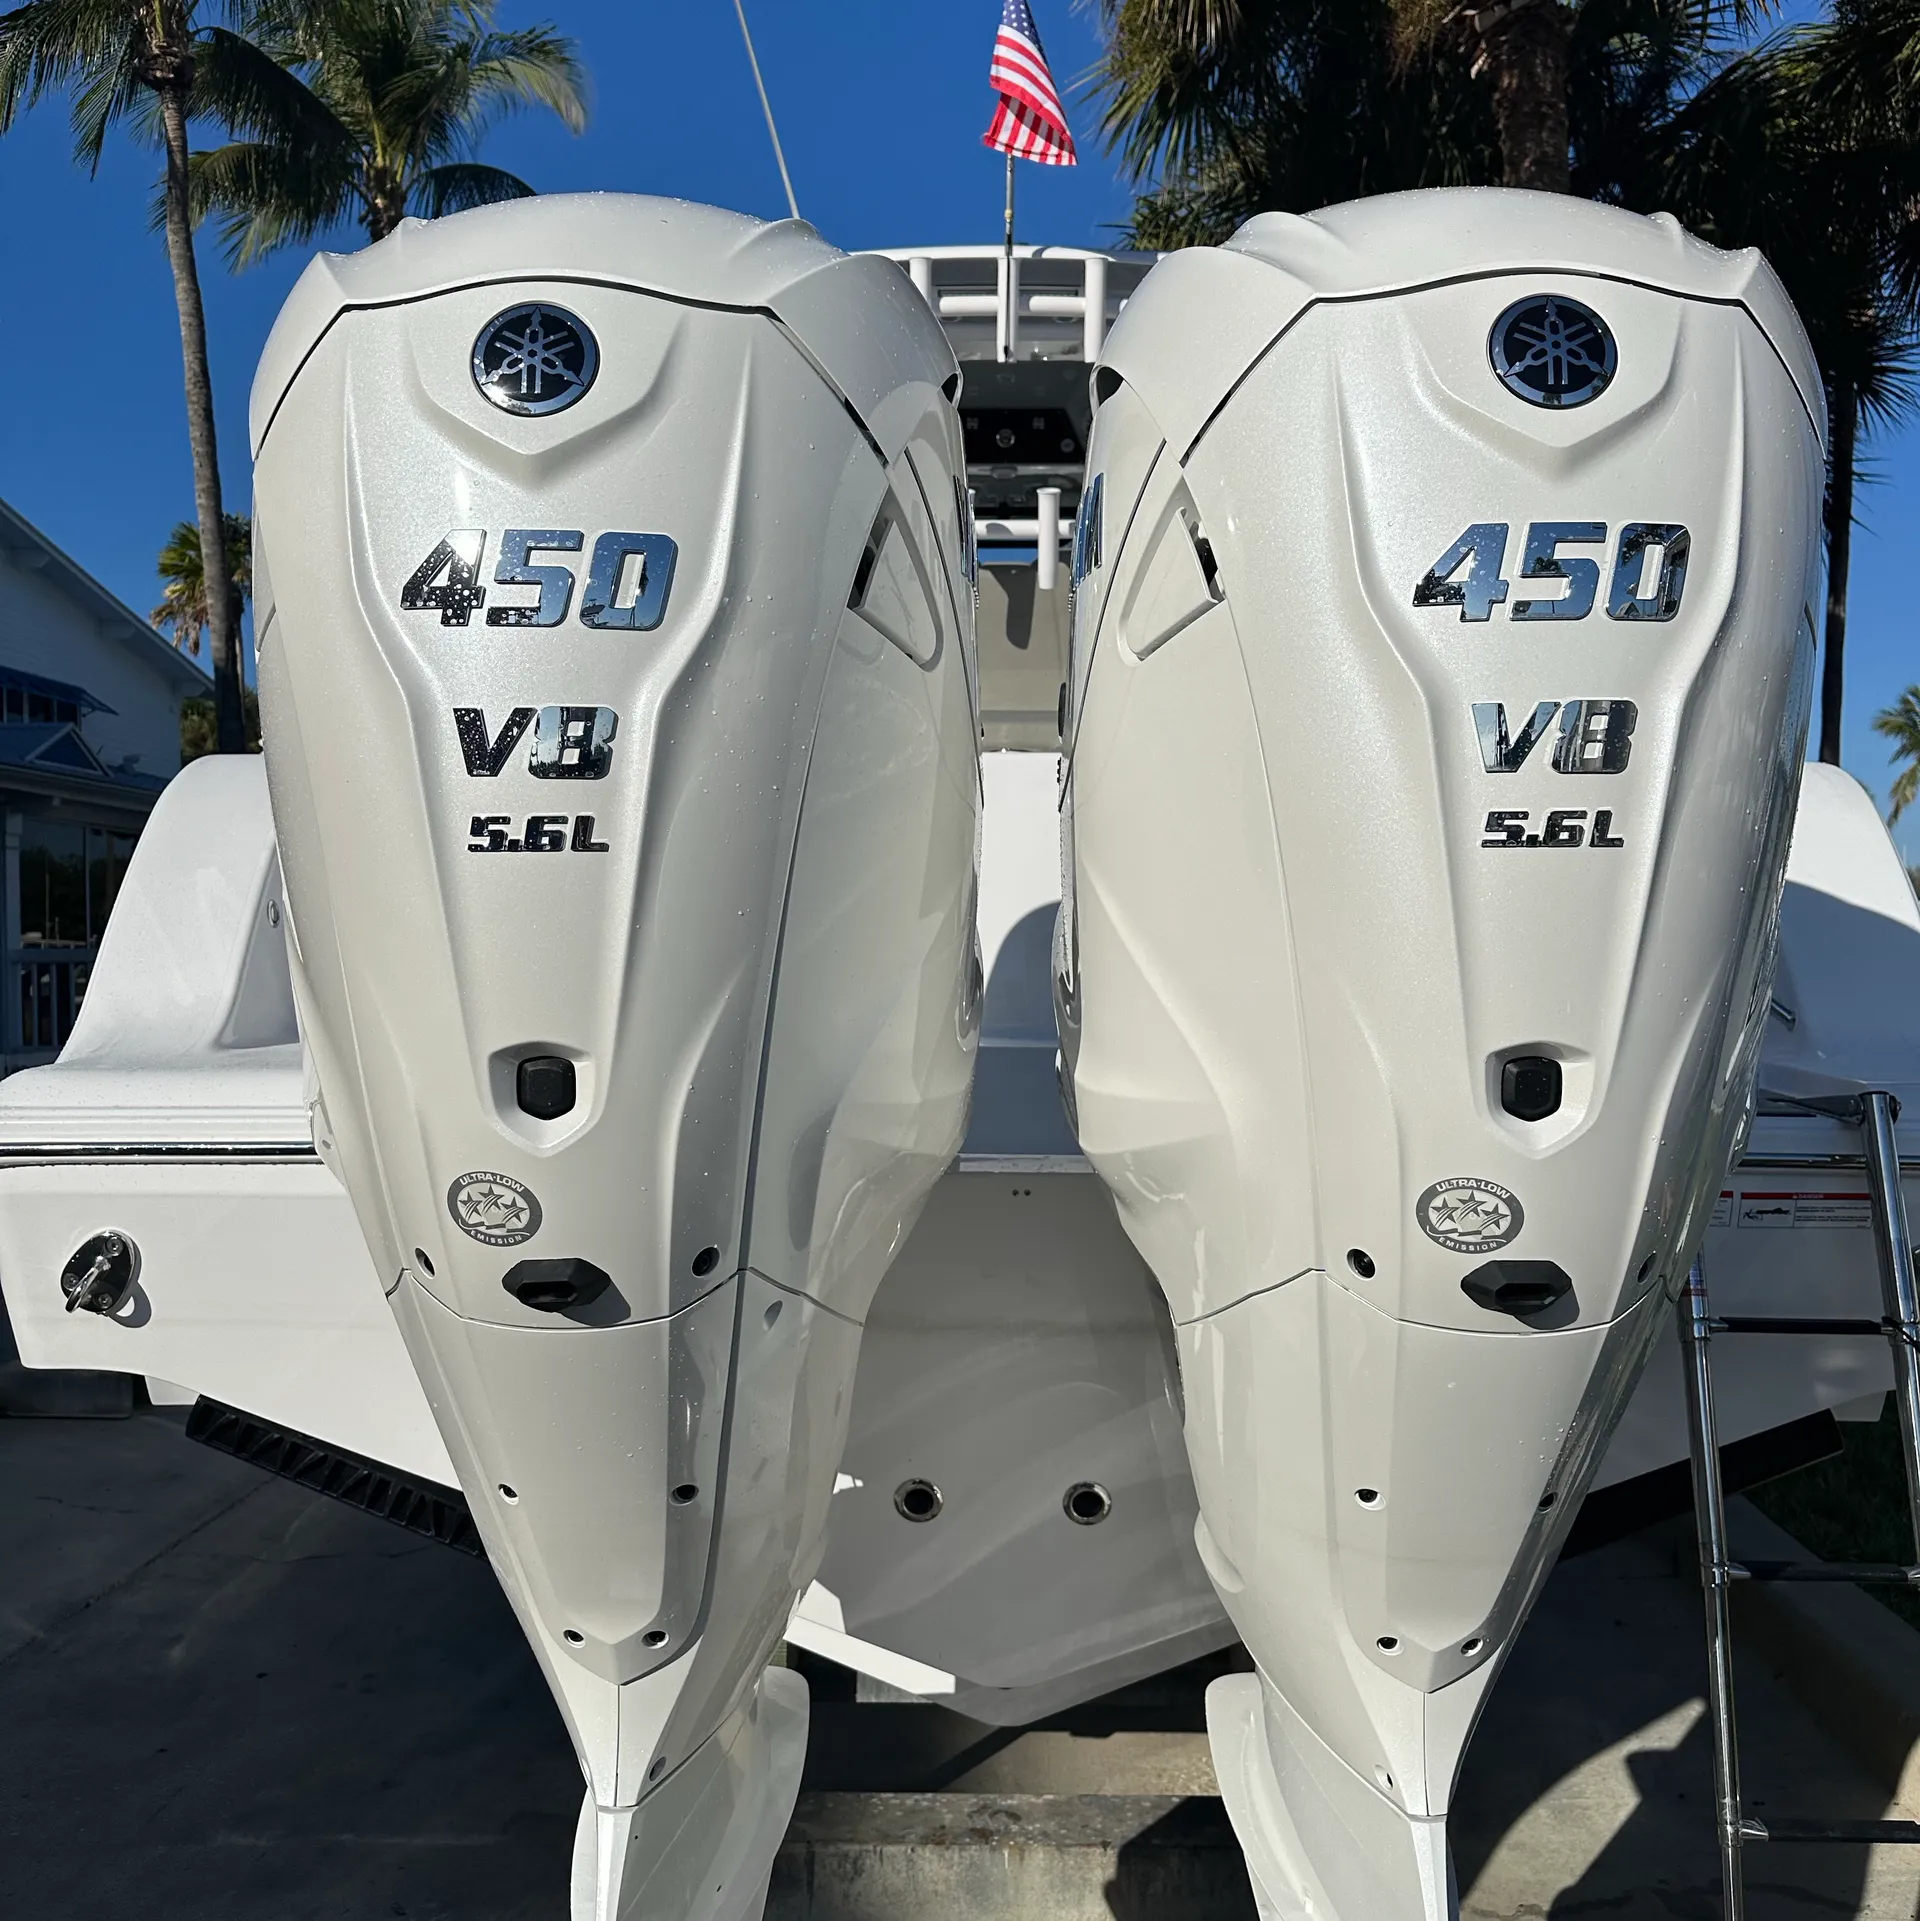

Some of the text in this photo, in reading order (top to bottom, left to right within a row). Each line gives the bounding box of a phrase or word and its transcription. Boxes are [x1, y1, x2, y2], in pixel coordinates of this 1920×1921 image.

[400, 528, 679, 631] 450
[1412, 521, 1691, 622] 450
[452, 705, 619, 780] V8
[1471, 699, 1638, 774] V8
[467, 814, 609, 853] 5.6L
[1481, 810, 1624, 848] 5.6L
[470, 1229, 523, 1244] EMISSION
[1438, 1236, 1498, 1251] EMISSION
